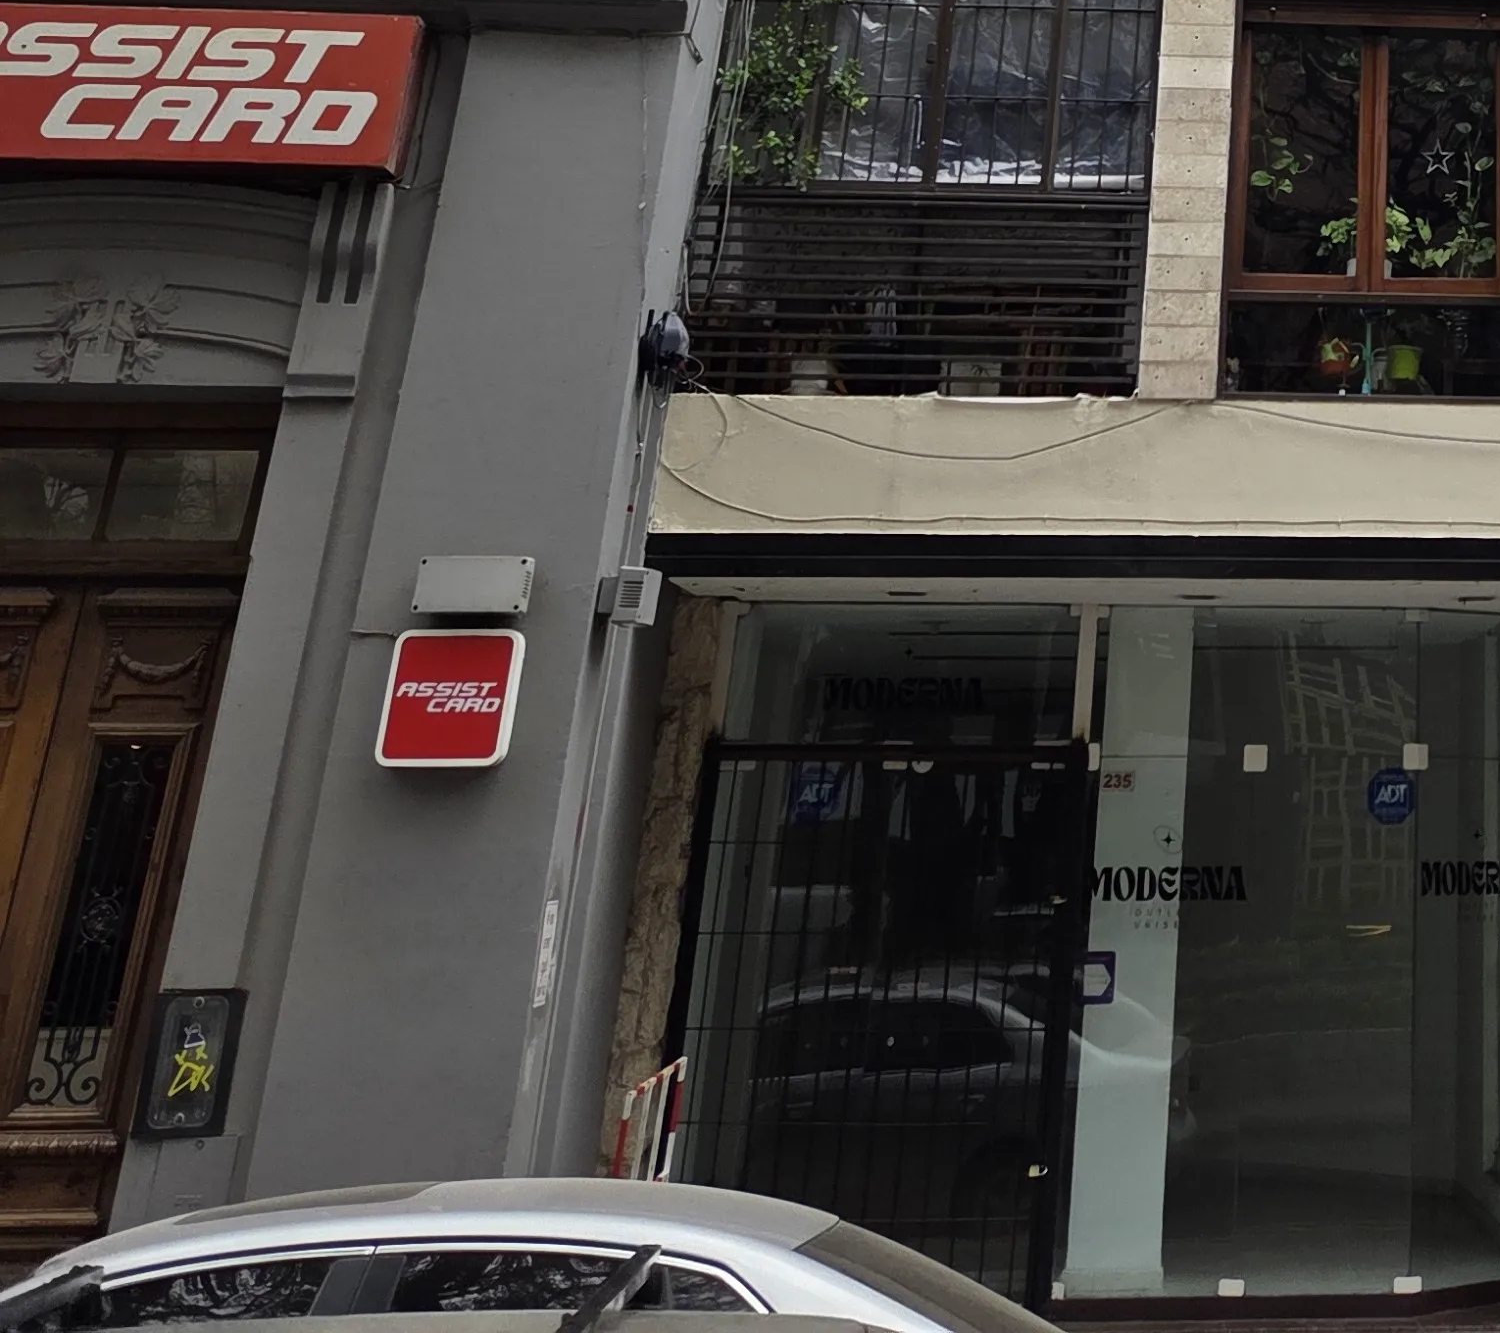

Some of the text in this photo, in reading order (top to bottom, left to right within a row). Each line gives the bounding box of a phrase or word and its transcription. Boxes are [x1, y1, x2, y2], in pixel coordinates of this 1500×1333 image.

[0, 21, 365, 84] SSIST
[40, 84, 378, 146] CARD
[396, 681, 498, 698] ASSIST
[823, 676, 985, 711] MODERNA
[426, 697, 501, 713] CARD
[1103, 773, 1132, 789] 235
[1374, 784, 1408, 804] ADT
[1089, 865, 1248, 902] MODERNA
